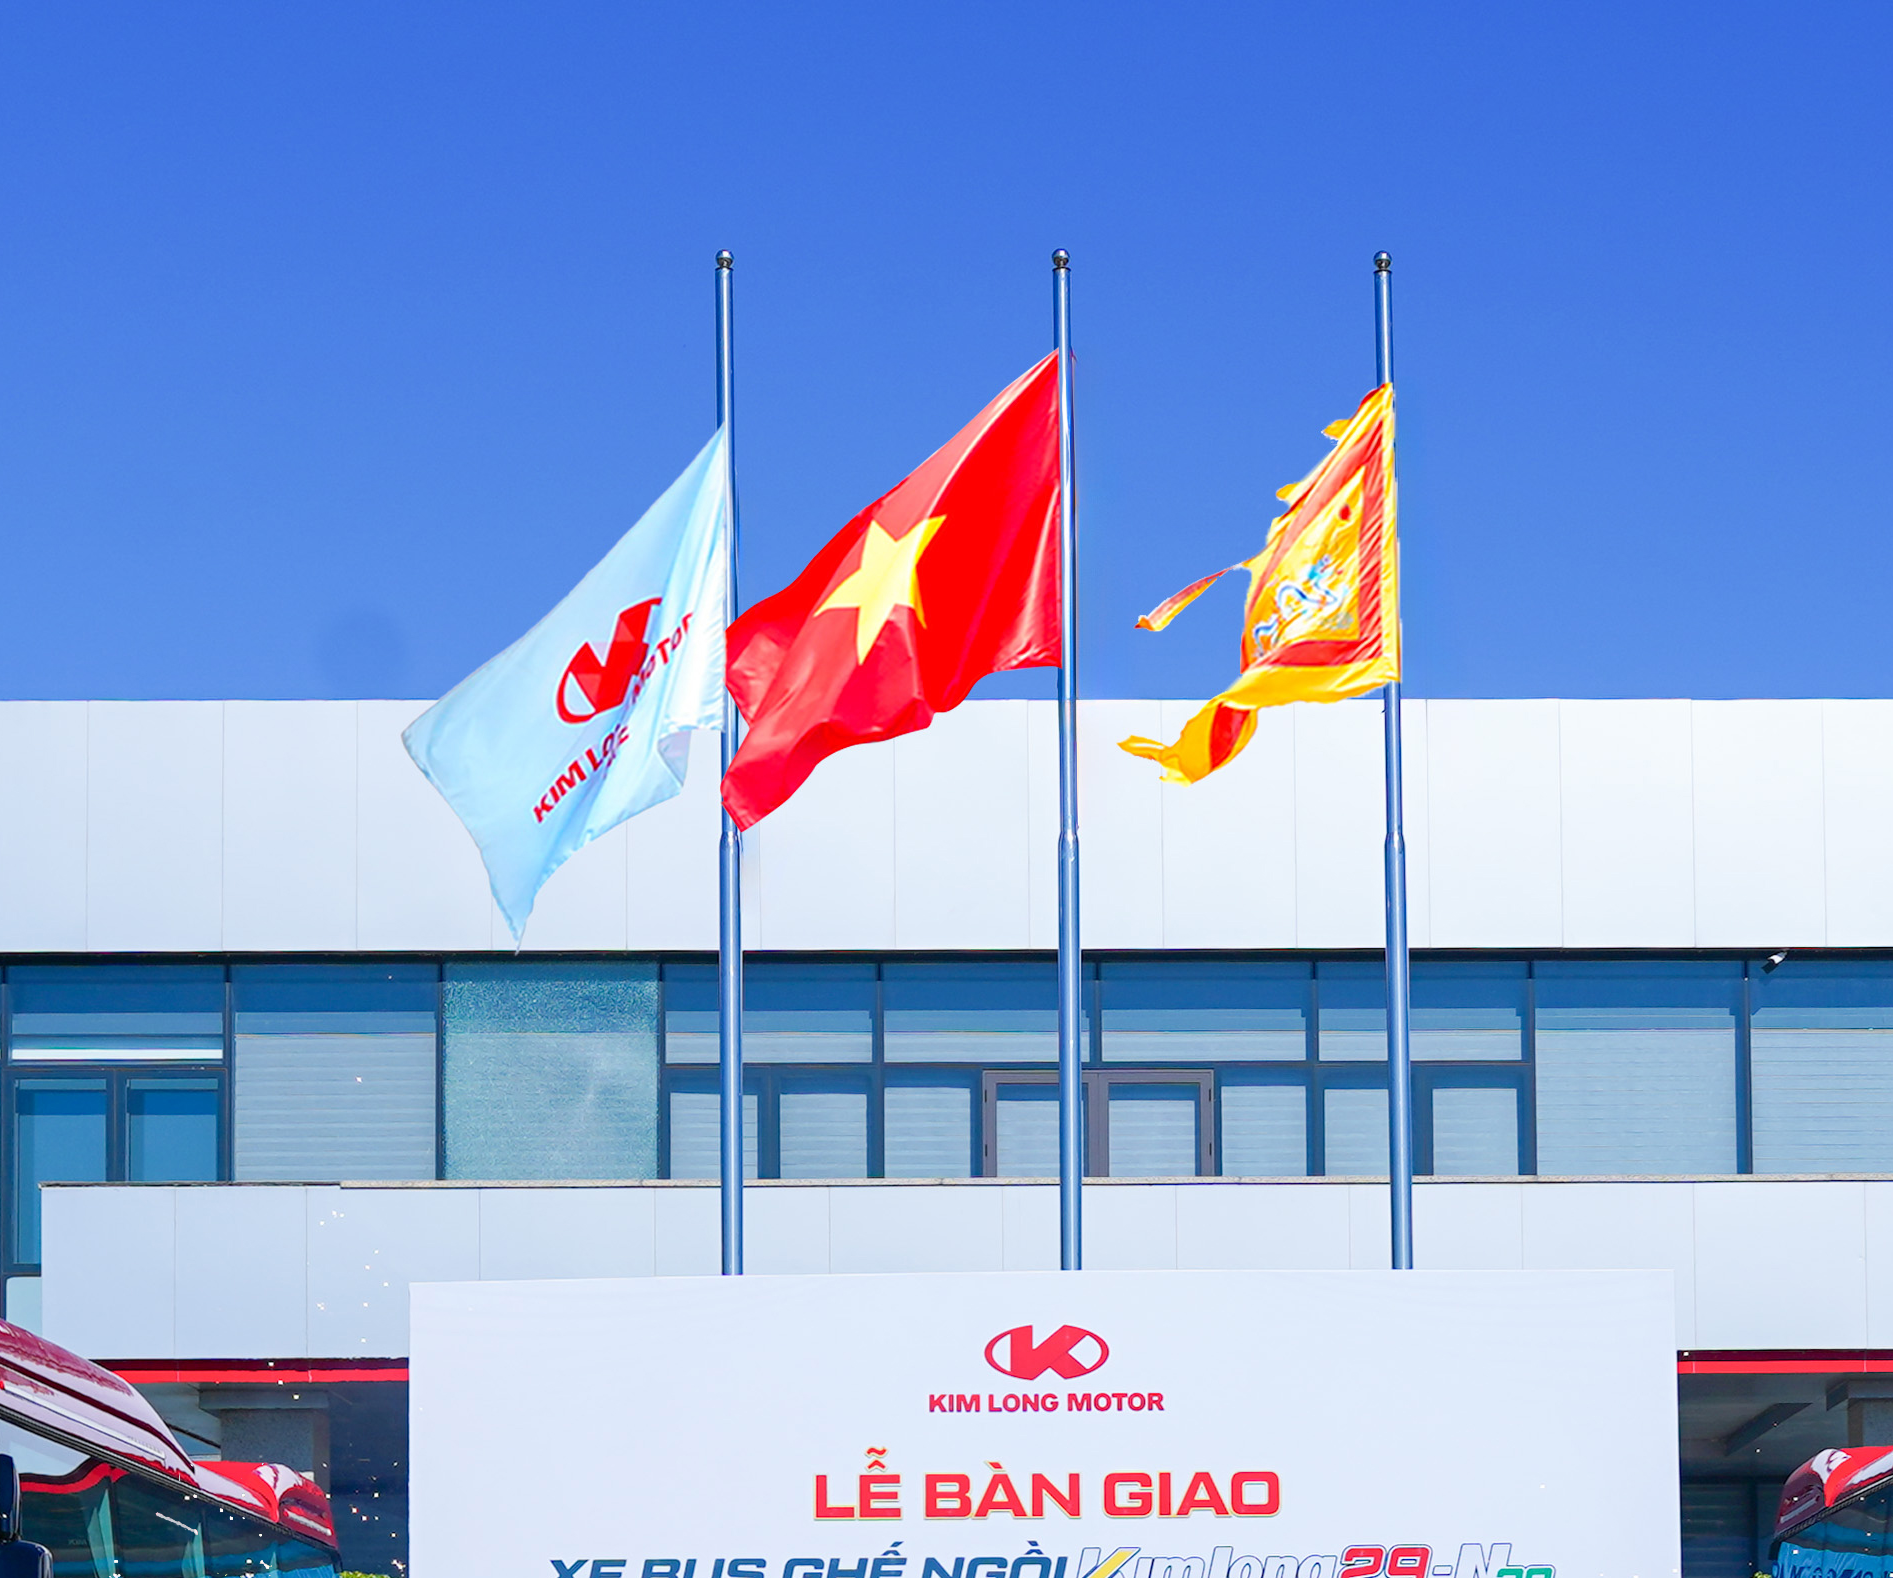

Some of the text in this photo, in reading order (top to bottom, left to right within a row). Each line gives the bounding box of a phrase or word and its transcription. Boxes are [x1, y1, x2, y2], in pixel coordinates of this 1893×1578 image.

[534, 759, 587, 824] KIM
[929, 1392, 1165, 1413] KIM LONG MOTOR
[813, 1446, 1281, 1522] LỄ BÀN GIAO
